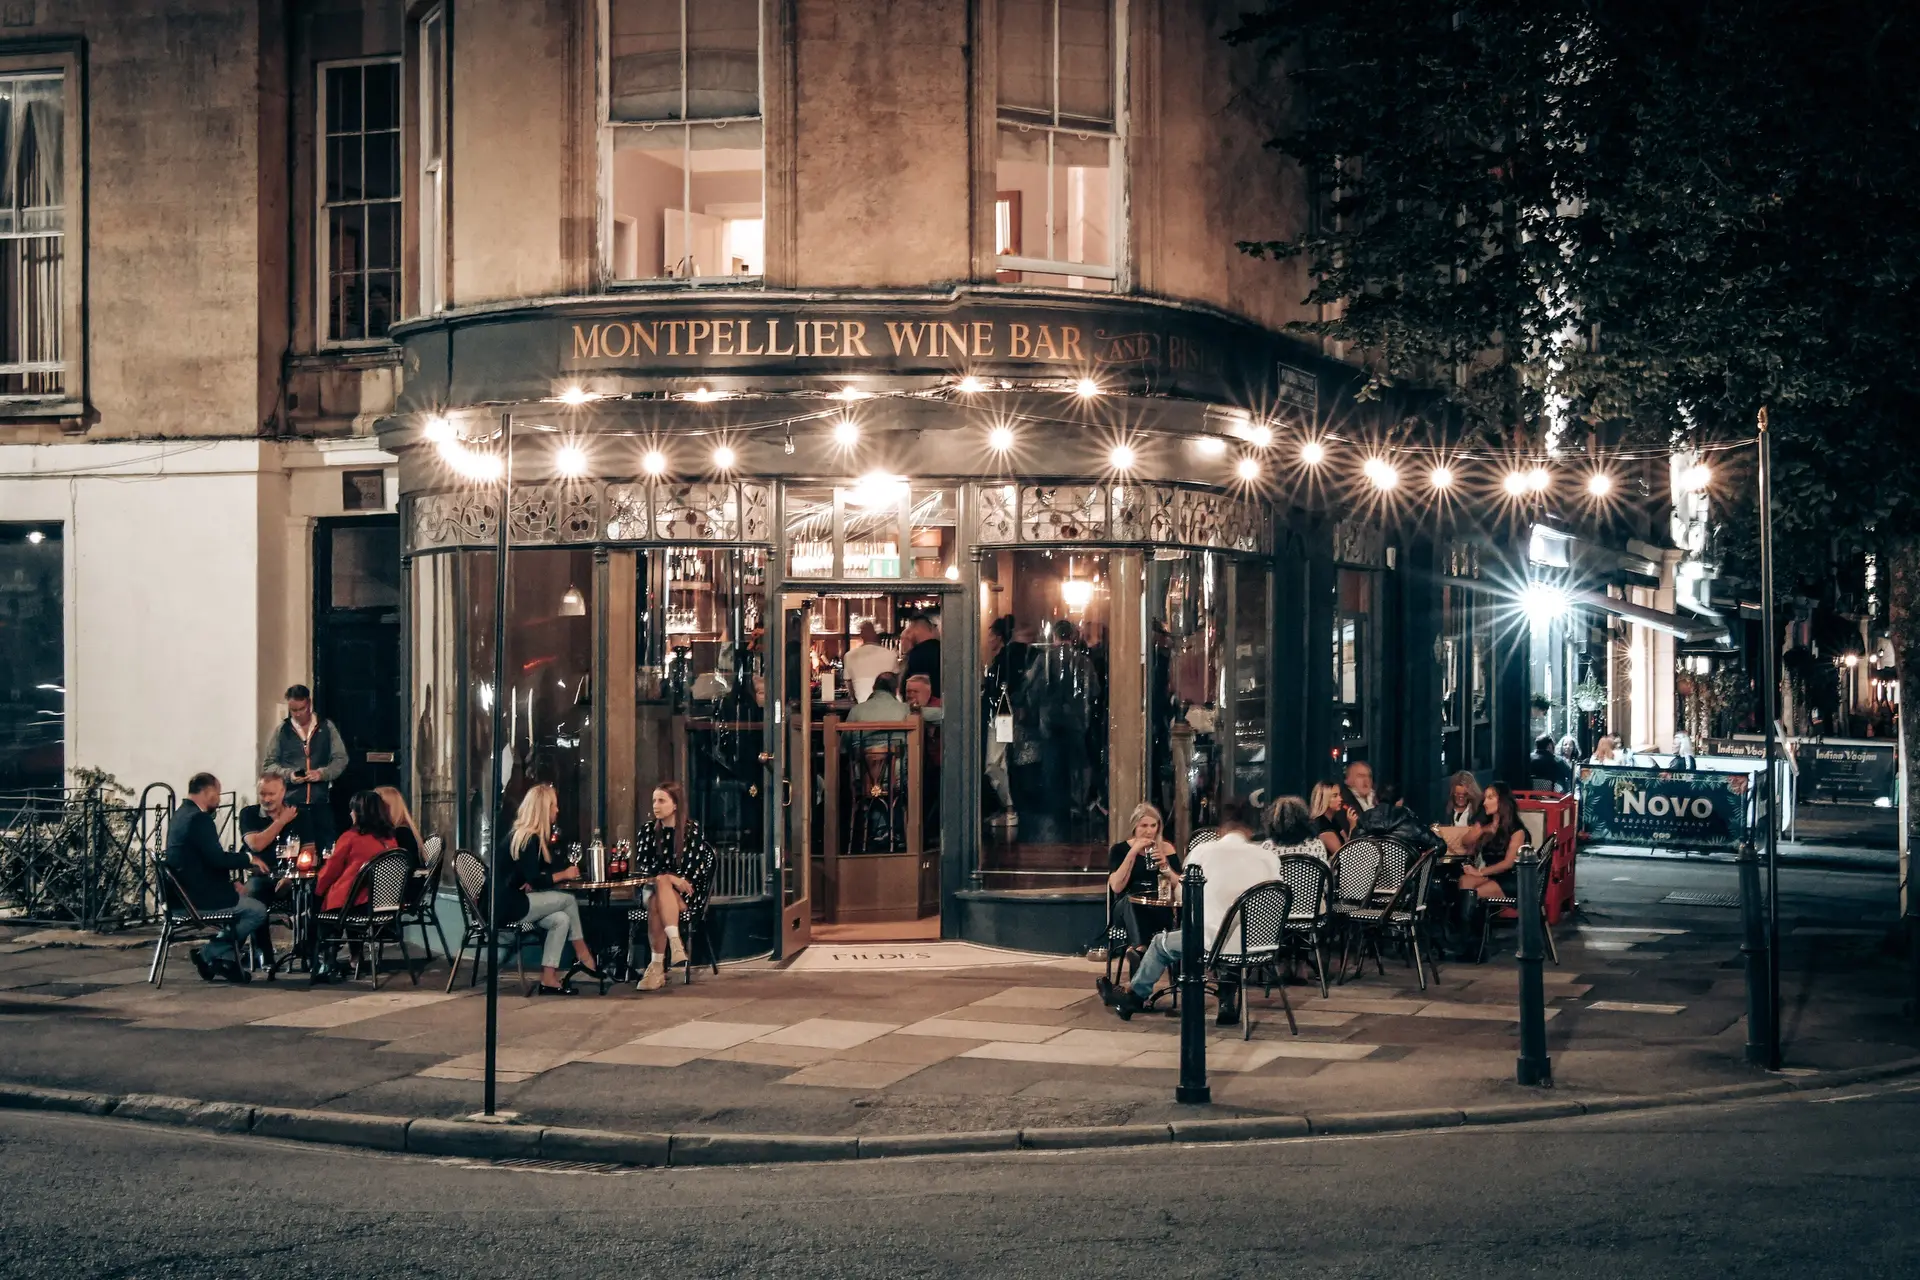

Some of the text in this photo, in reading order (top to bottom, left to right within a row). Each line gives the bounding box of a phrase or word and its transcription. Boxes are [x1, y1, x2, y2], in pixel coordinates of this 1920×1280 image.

[572, 320, 873, 359] MONTPELLIER
[884, 320, 995, 358] WINE
[1008, 323, 1086, 361] BAR
[1109, 337, 1150, 360] AND
[1745, 744, 1767, 758] Vooj
